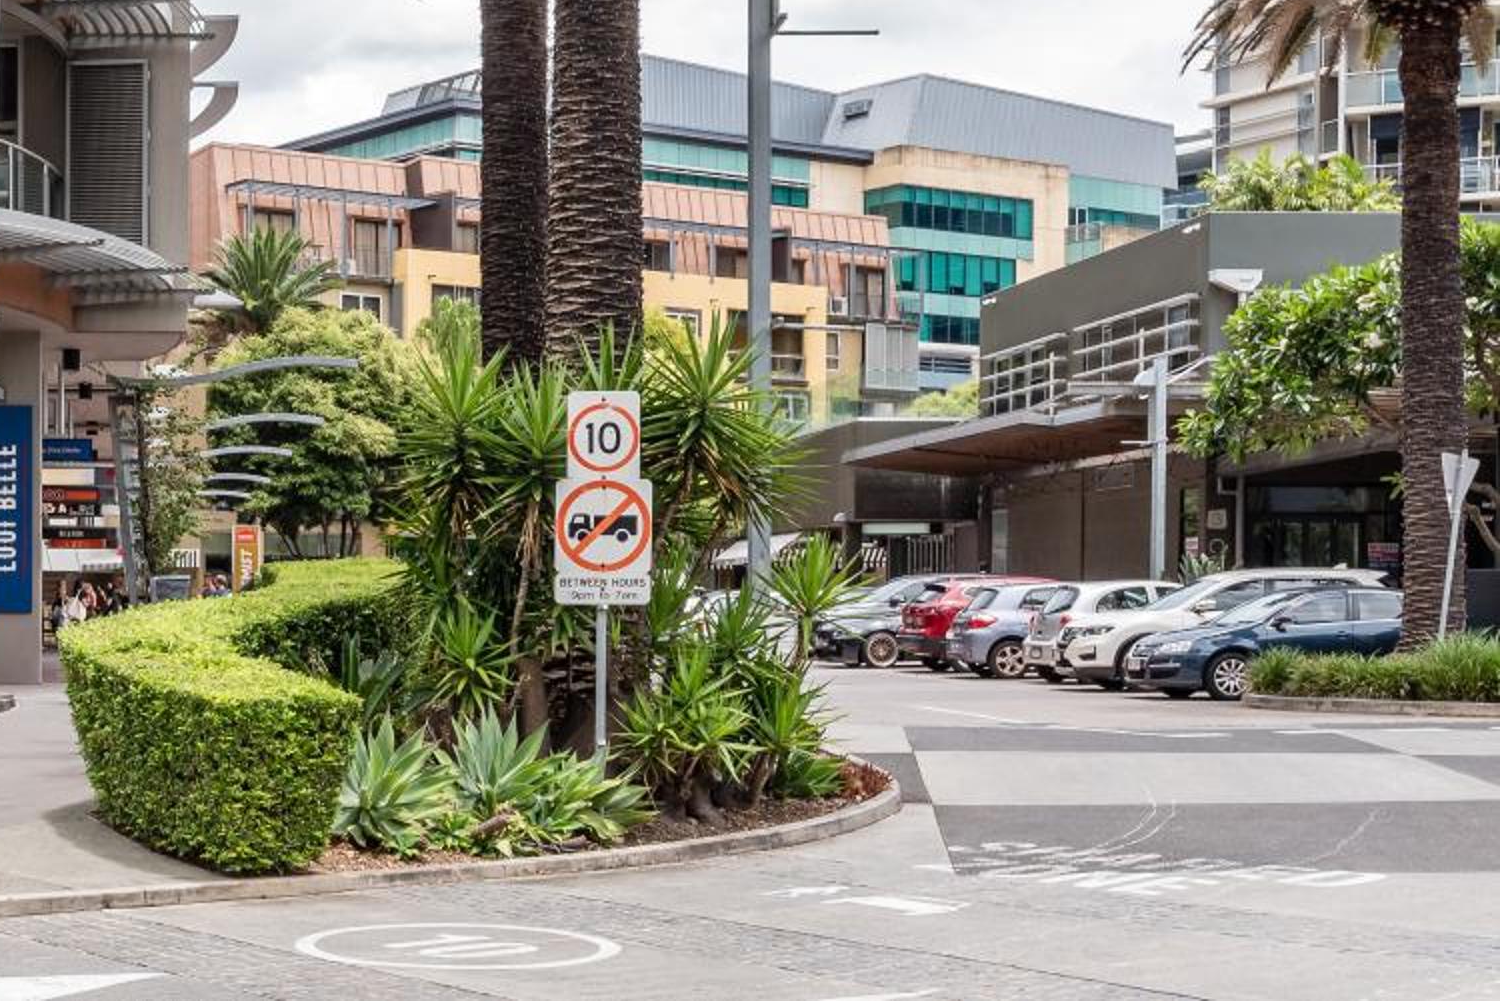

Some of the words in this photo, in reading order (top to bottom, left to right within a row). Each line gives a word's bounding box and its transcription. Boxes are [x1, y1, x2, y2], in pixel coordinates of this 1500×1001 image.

[585, 422, 621, 454] 10
[611, 578, 647, 588] HOURS
[381, 932, 539, 959] 10
